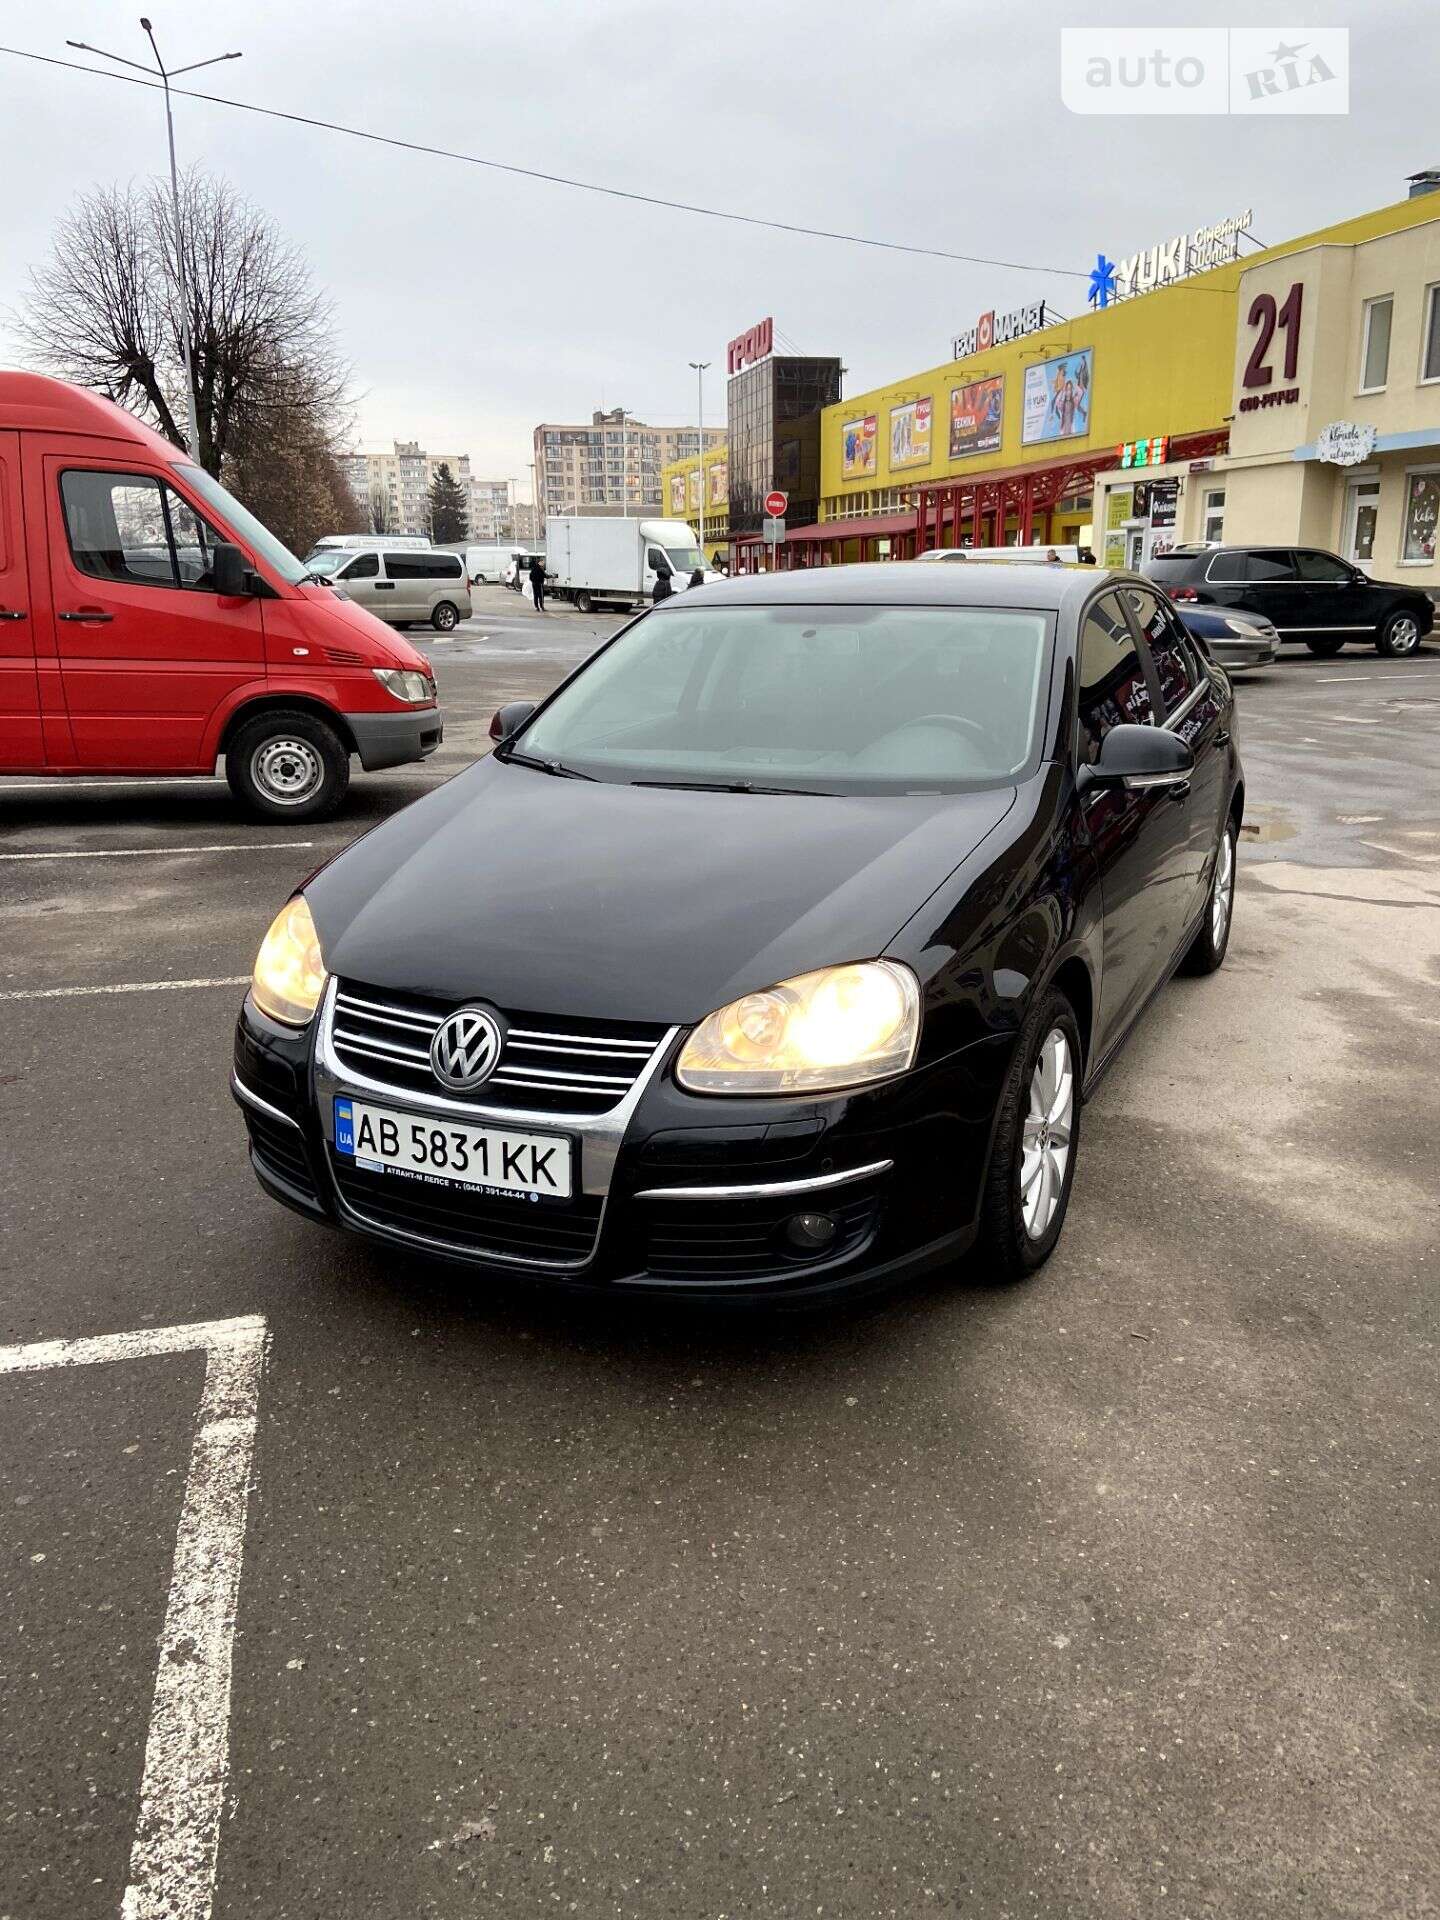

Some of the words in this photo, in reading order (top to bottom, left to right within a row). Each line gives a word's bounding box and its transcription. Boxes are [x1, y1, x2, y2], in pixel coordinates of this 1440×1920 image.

[1194, 208, 1253, 247] Сімейний
[1120, 235, 1188, 295] YUKI
[727, 316, 774, 375] ГРОШ
[1243, 282, 1304, 389] 21
[339, 1131, 353, 1147] UA
[356, 1113, 400, 1157] AB
[410, 1124, 489, 1177] 5831
[502, 1141, 558, 1188] KK
